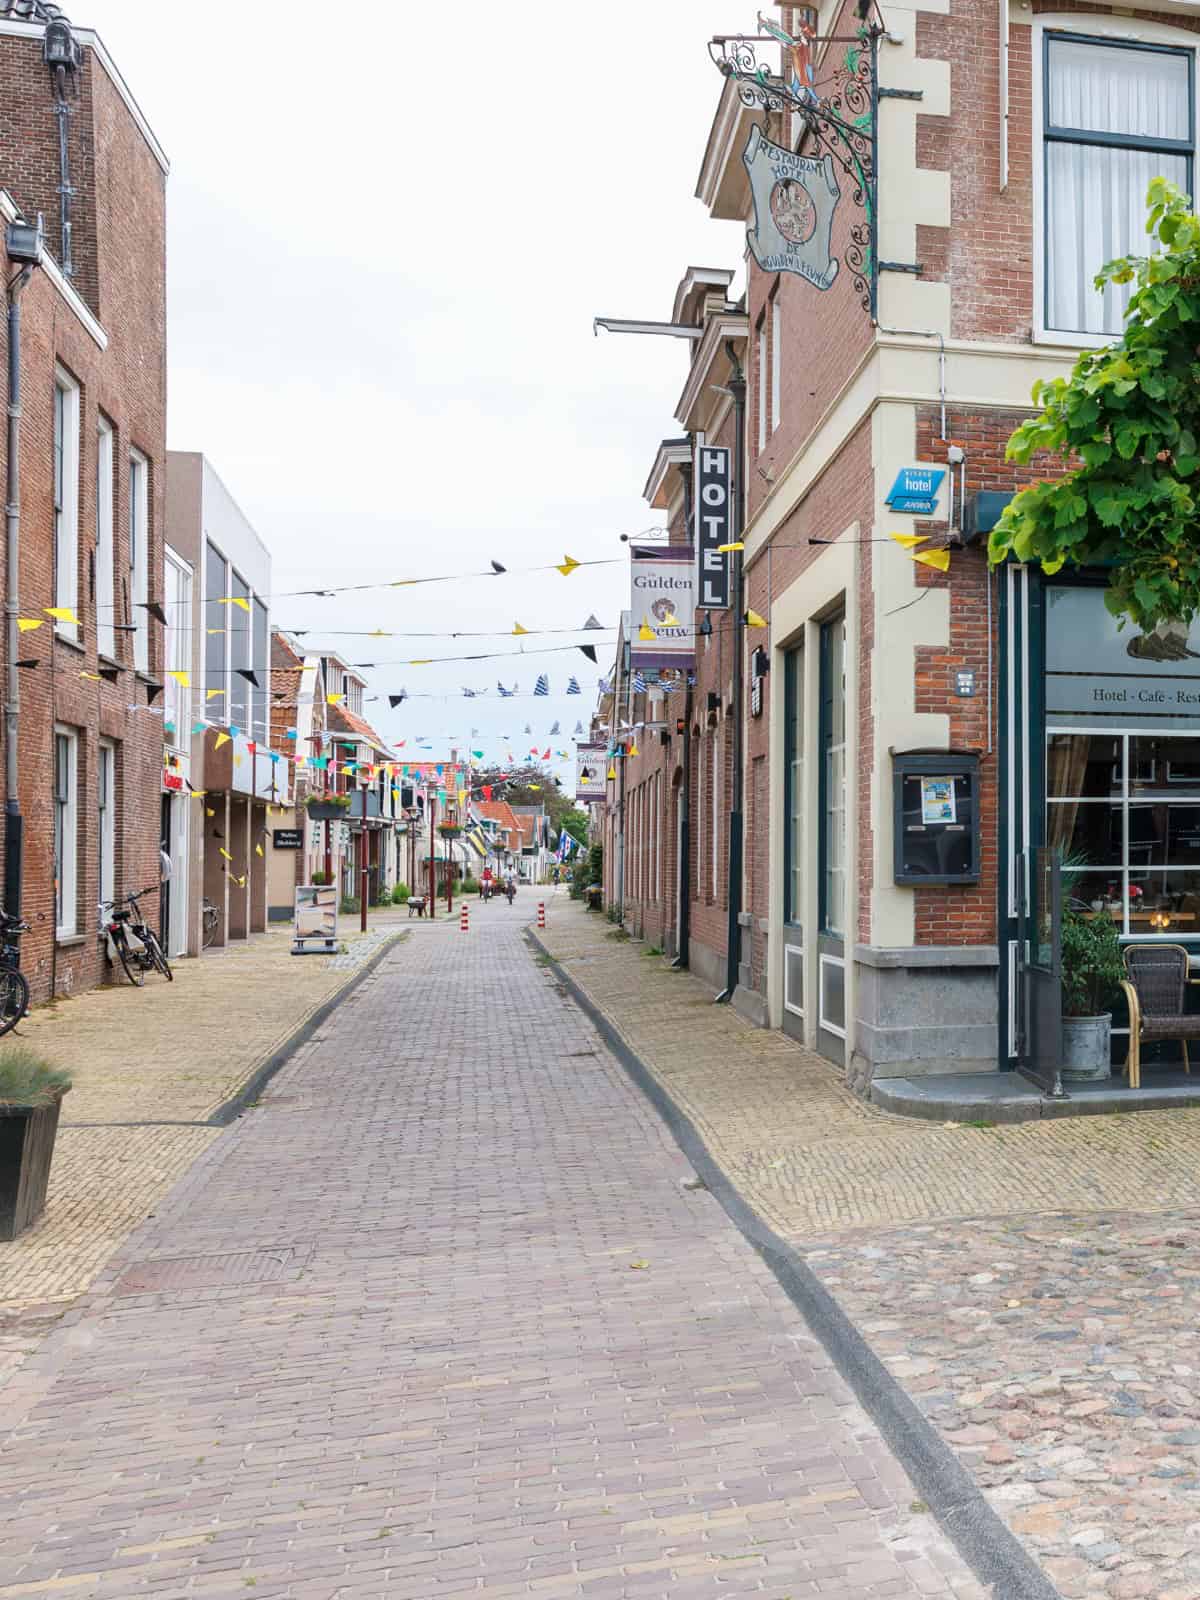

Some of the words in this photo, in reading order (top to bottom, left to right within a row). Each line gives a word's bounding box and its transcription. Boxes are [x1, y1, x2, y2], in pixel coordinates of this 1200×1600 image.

[759, 141, 824, 178] RESTAURANT
[771, 165, 808, 186] HOTEL
[786, 242, 800, 254] DE
[905, 477, 932, 492] hotel
[702, 450, 724, 604] HOTEL
[634, 575, 693, 589] Gulden
[1092, 688, 1127, 702] Hotel
